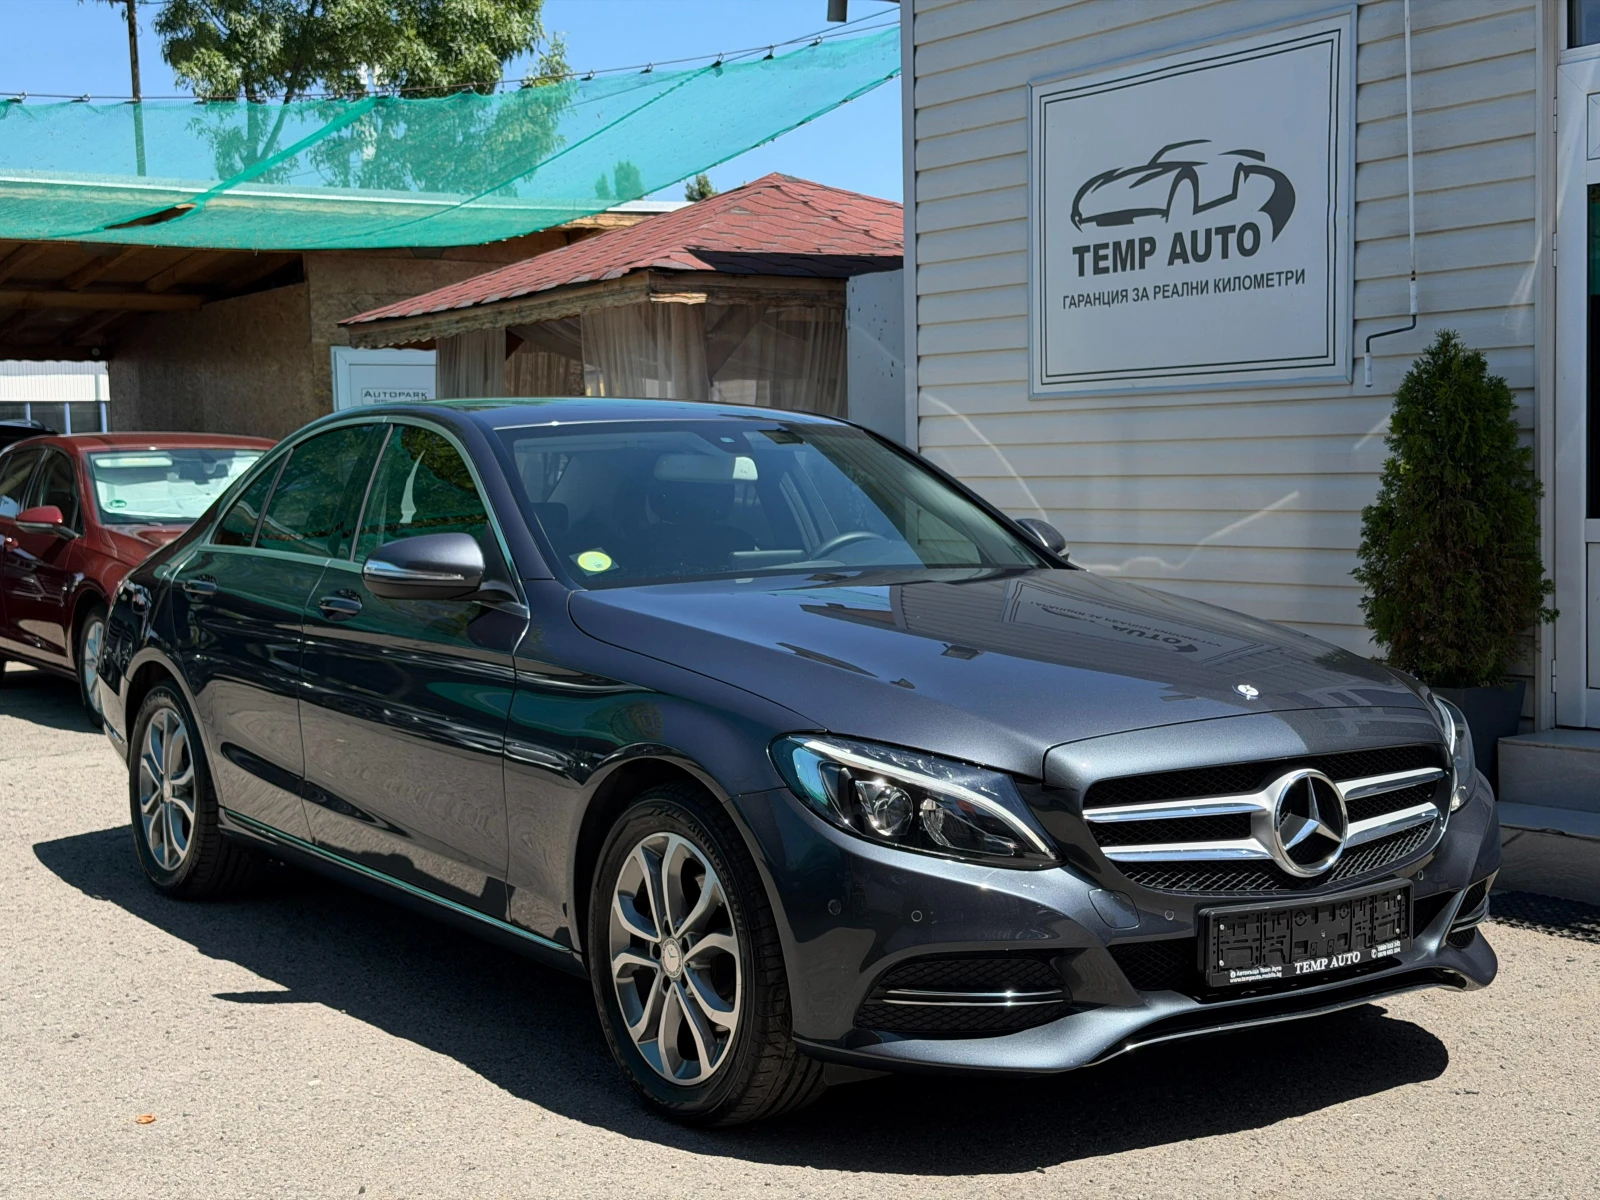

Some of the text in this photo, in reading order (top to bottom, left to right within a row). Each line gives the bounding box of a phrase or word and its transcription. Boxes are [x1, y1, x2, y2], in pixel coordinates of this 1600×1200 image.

[1072, 221, 1261, 278] TEMP AUTO
[1062, 268, 1306, 310] ГАРАНЦИЯ ЗА РЕАЛНИ КИЛОМЕТРИ
[363, 390, 428, 400] AUTOPARK
[1294, 951, 1361, 974] TEMP AUTO
